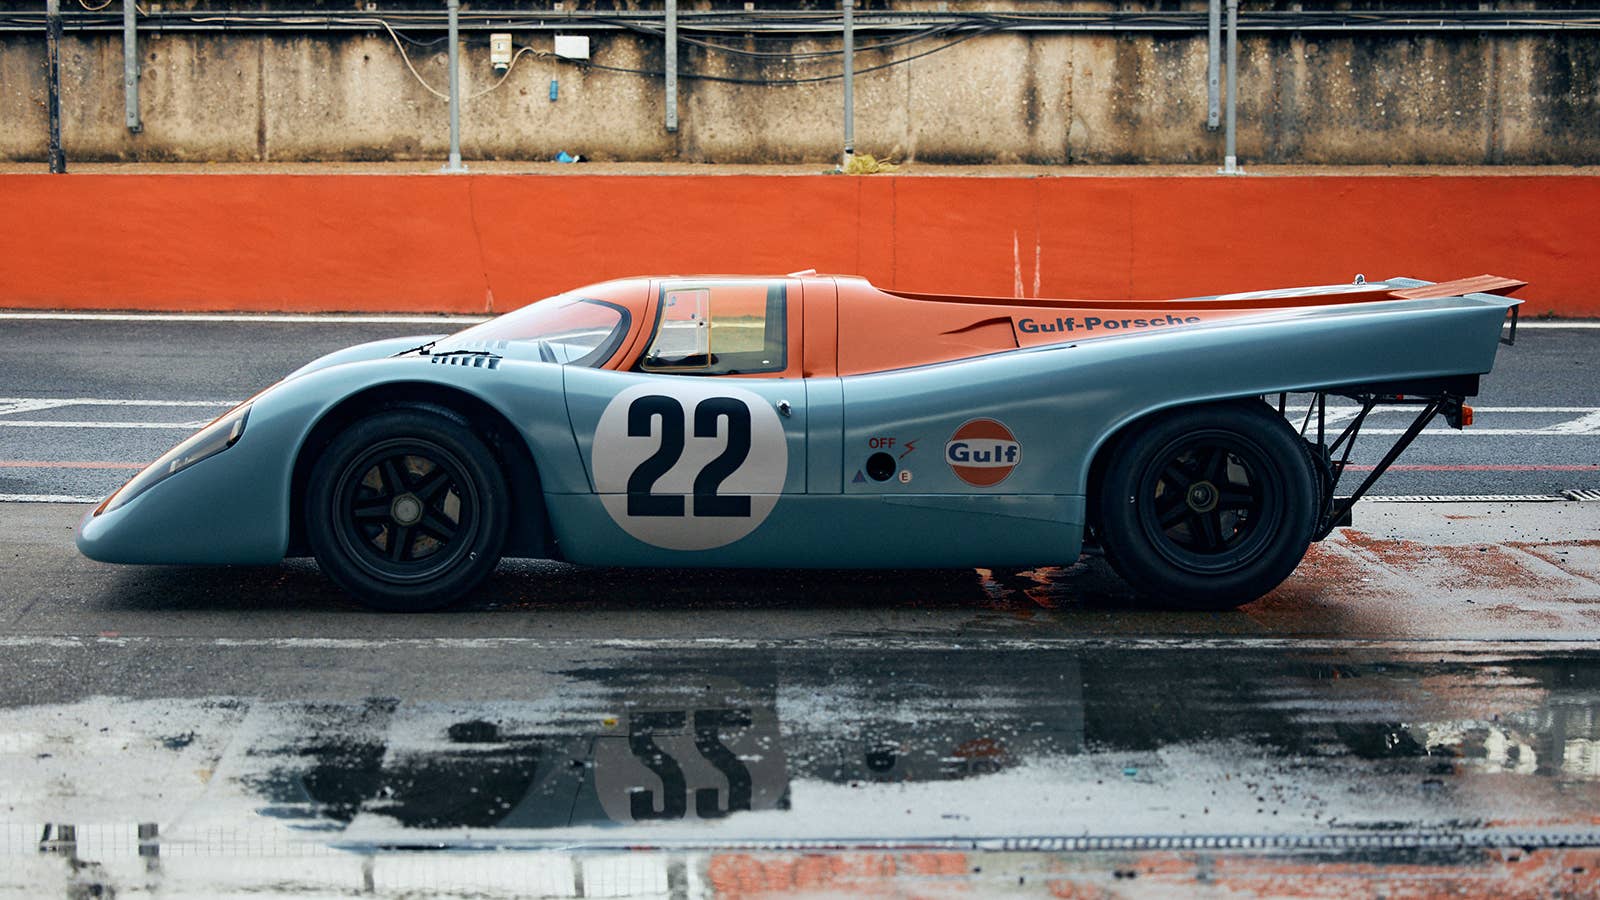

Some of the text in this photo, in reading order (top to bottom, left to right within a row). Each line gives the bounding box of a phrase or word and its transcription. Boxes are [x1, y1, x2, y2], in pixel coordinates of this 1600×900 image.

[1018, 314, 1201, 333] Gulf-Porsche
[868, 437, 896, 449] OFF
[948, 442, 1018, 463] Gulf
[627, 395, 752, 517] 22
